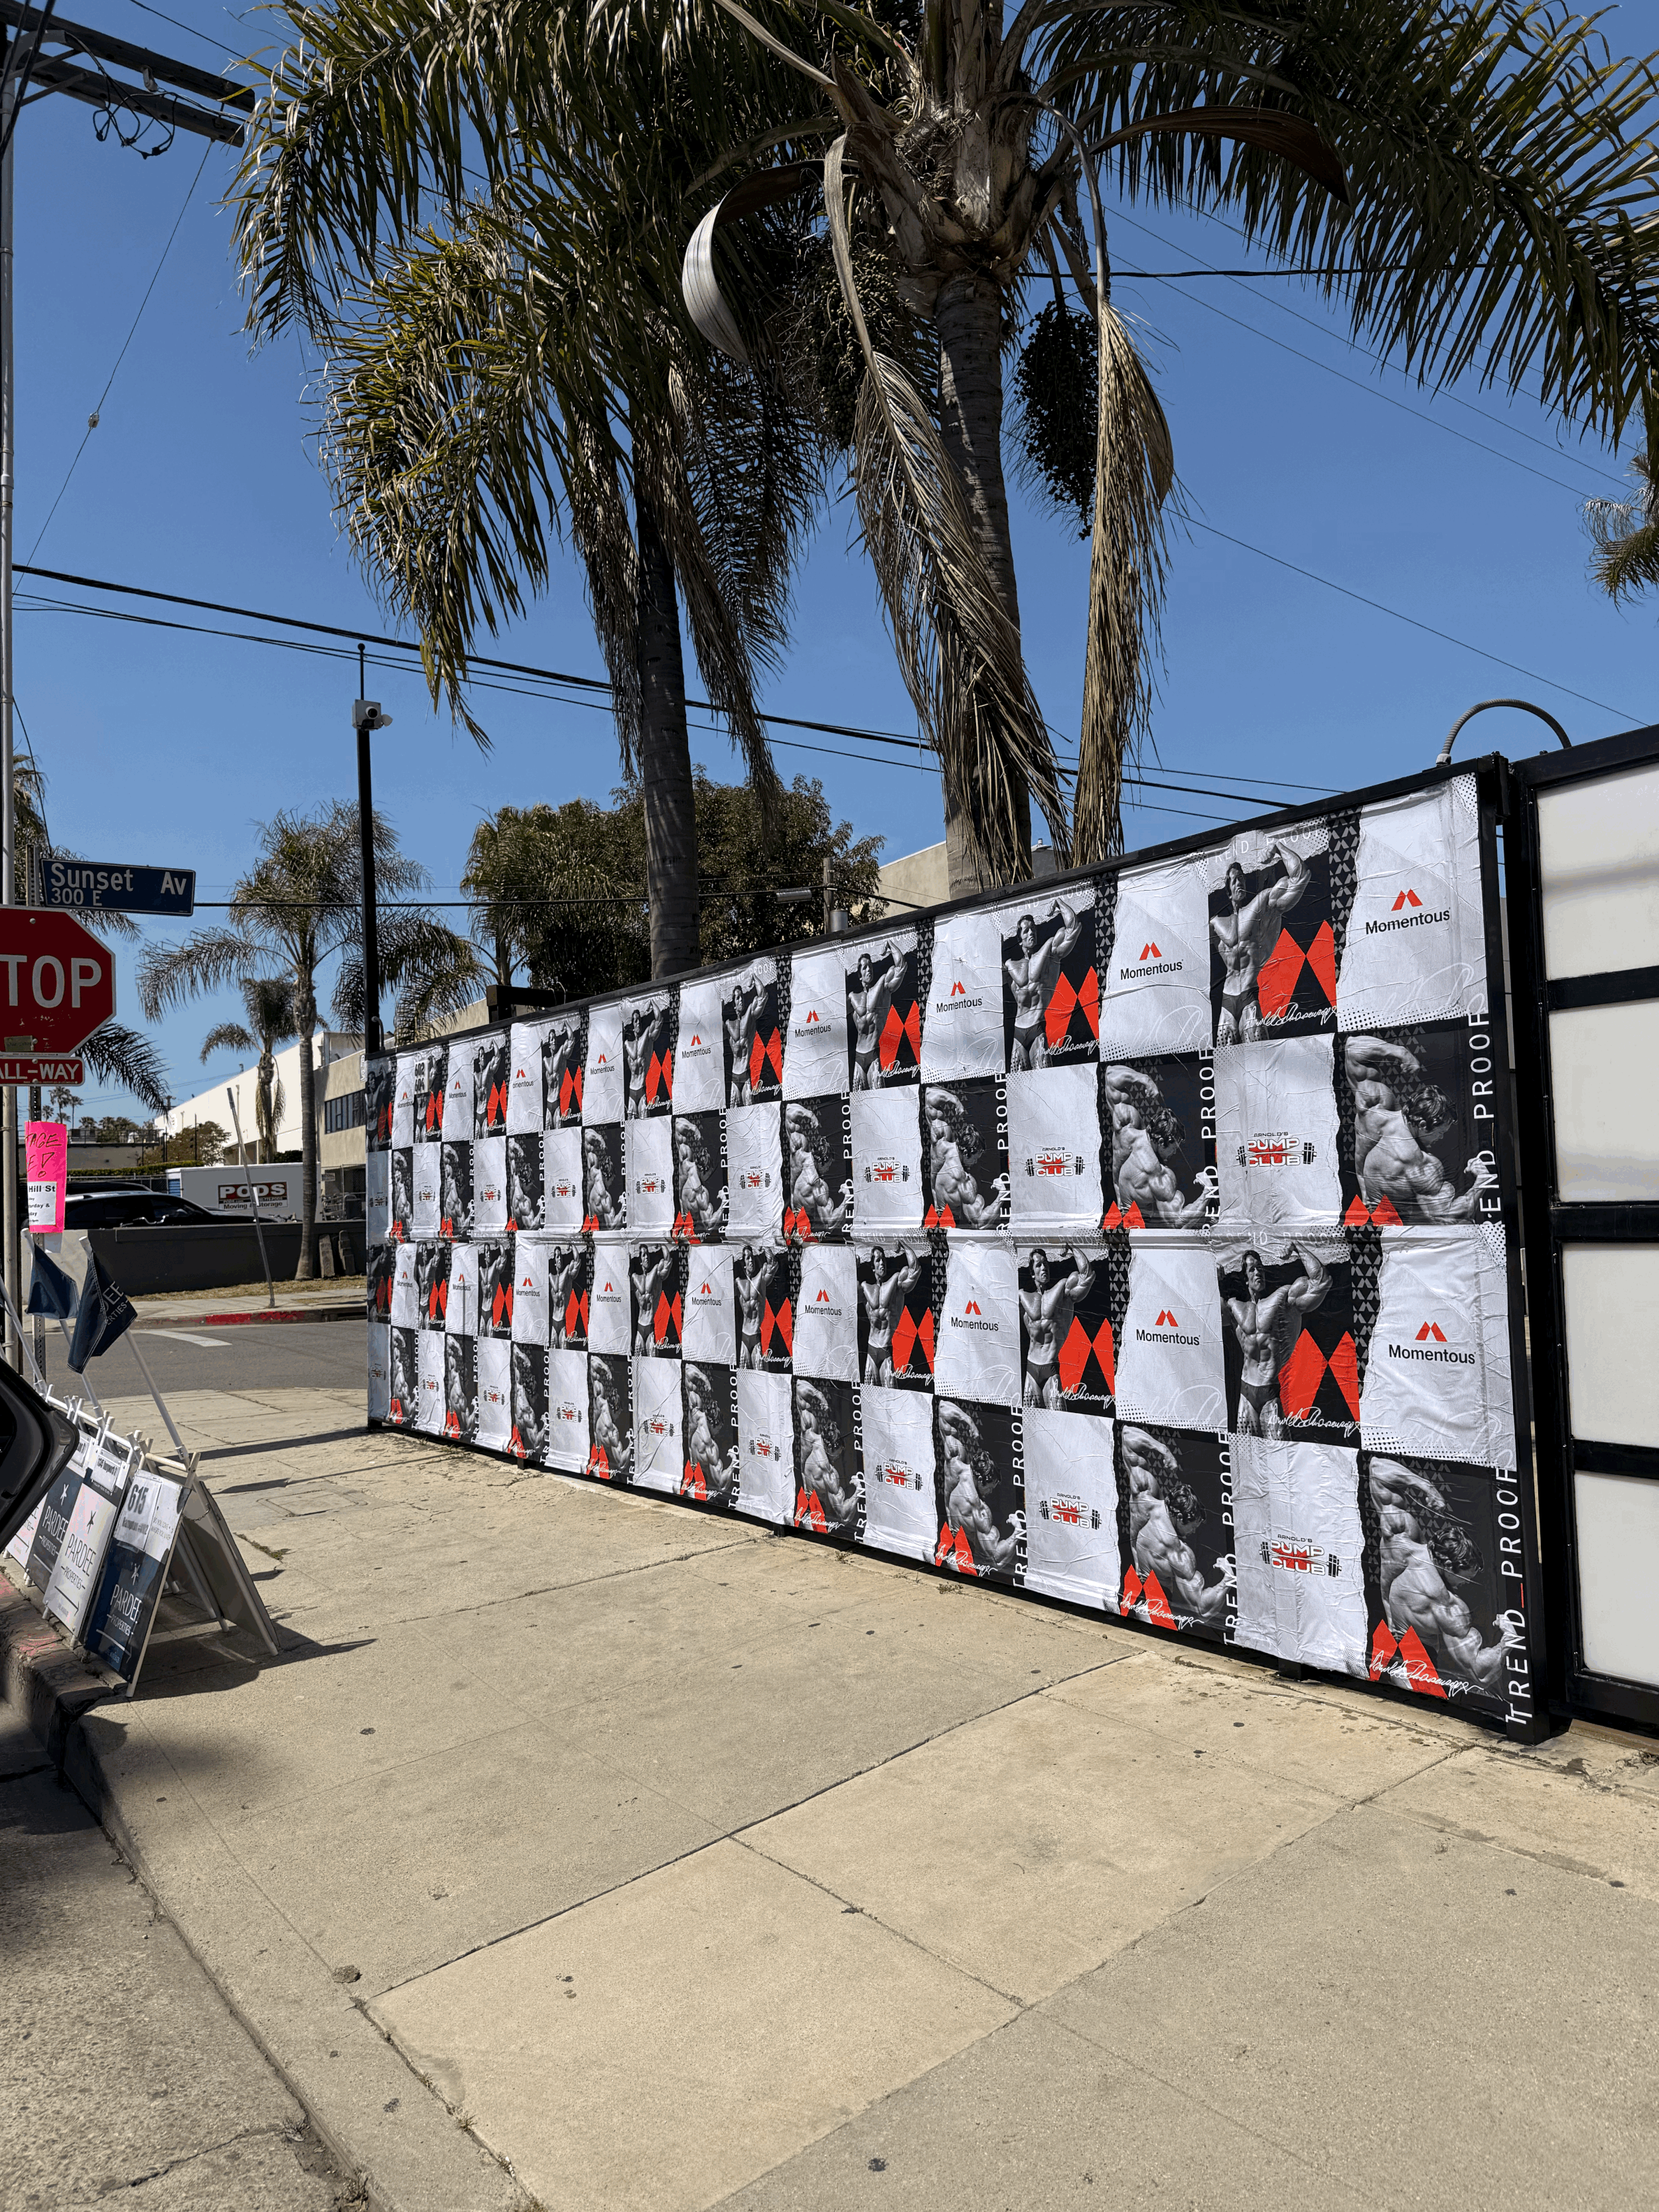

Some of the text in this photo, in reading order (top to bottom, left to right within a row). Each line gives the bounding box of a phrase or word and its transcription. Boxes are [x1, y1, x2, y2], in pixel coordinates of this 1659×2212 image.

[51, 863, 186, 895] Sunset Av
[51, 888, 102, 906] 300 E
[1366, 908, 1449, 934] Momentous
[1120, 962, 1183, 980] Momentous
[0, 954, 102, 1008] TOP
[936, 998, 982, 1013] Momentous
[795, 1025, 831, 1038] Momentous
[682, 1047, 711, 1059] Momentous
[415, 1063, 425, 1076] 602
[590, 1065, 614, 1075] Momentous
[1469, 1013, 1495, 1120] PROOF
[512, 1080, 534, 1088] omentous
[1198, 1050, 1216, 1140] PROOF
[995, 1073, 1010, 1149] PROOF
[841, 1092, 853, 1159] PROOF
[719, 1108, 729, 1167] PROOF
[1248, 1138, 1300, 1150] PUMP
[872, 1162, 901, 1171] PUMP
[1035, 1152, 1073, 1163] PUMP
[1248, 1155, 1301, 1167] CLUB
[872, 1174, 901, 1183] CLUB
[1035, 1167, 1074, 1177] CLUB
[219, 1183, 285, 1199] PODS
[692, 1297, 721, 1306] Momentous
[805, 1305, 841, 1315] Momentous
[106, 1301, 127, 1325] ERTIES
[951, 1317, 998, 1331] Momentous
[1136, 1329, 1200, 1346] Momentous
[1389, 1344, 1475, 1364] Momentous
[540, 1412, 549, 1463] TREND
[728, 1364, 740, 1509] TREND PROOF
[851, 1381, 867, 1542] TREND PROOF
[884, 1462, 913, 1475] PUMP
[884, 1476, 914, 1490] CLUB
[1011, 1406, 1028, 1587] TREND PROOF
[1050, 1497, 1089, 1512] PUMP
[42, 1506, 68, 1544] PARDEE
[1050, 1512, 1090, 1529] CLUB
[1218, 1434, 1238, 1645] TREND PROOF
[1277, 1534, 1313, 1543] ARNOLD'S
[65, 1533, 96, 1577] PARDEE
[1270, 1539, 1325, 1557] PUMP
[1271, 1558, 1326, 1576] CLUB
[63, 1566, 82, 1590] PROPERTIES
[110, 1584, 142, 1622] PARDEE
[1496, 1468, 1534, 1724] TREND PROOF
[111, 1614, 131, 1637] PROPERTIES
